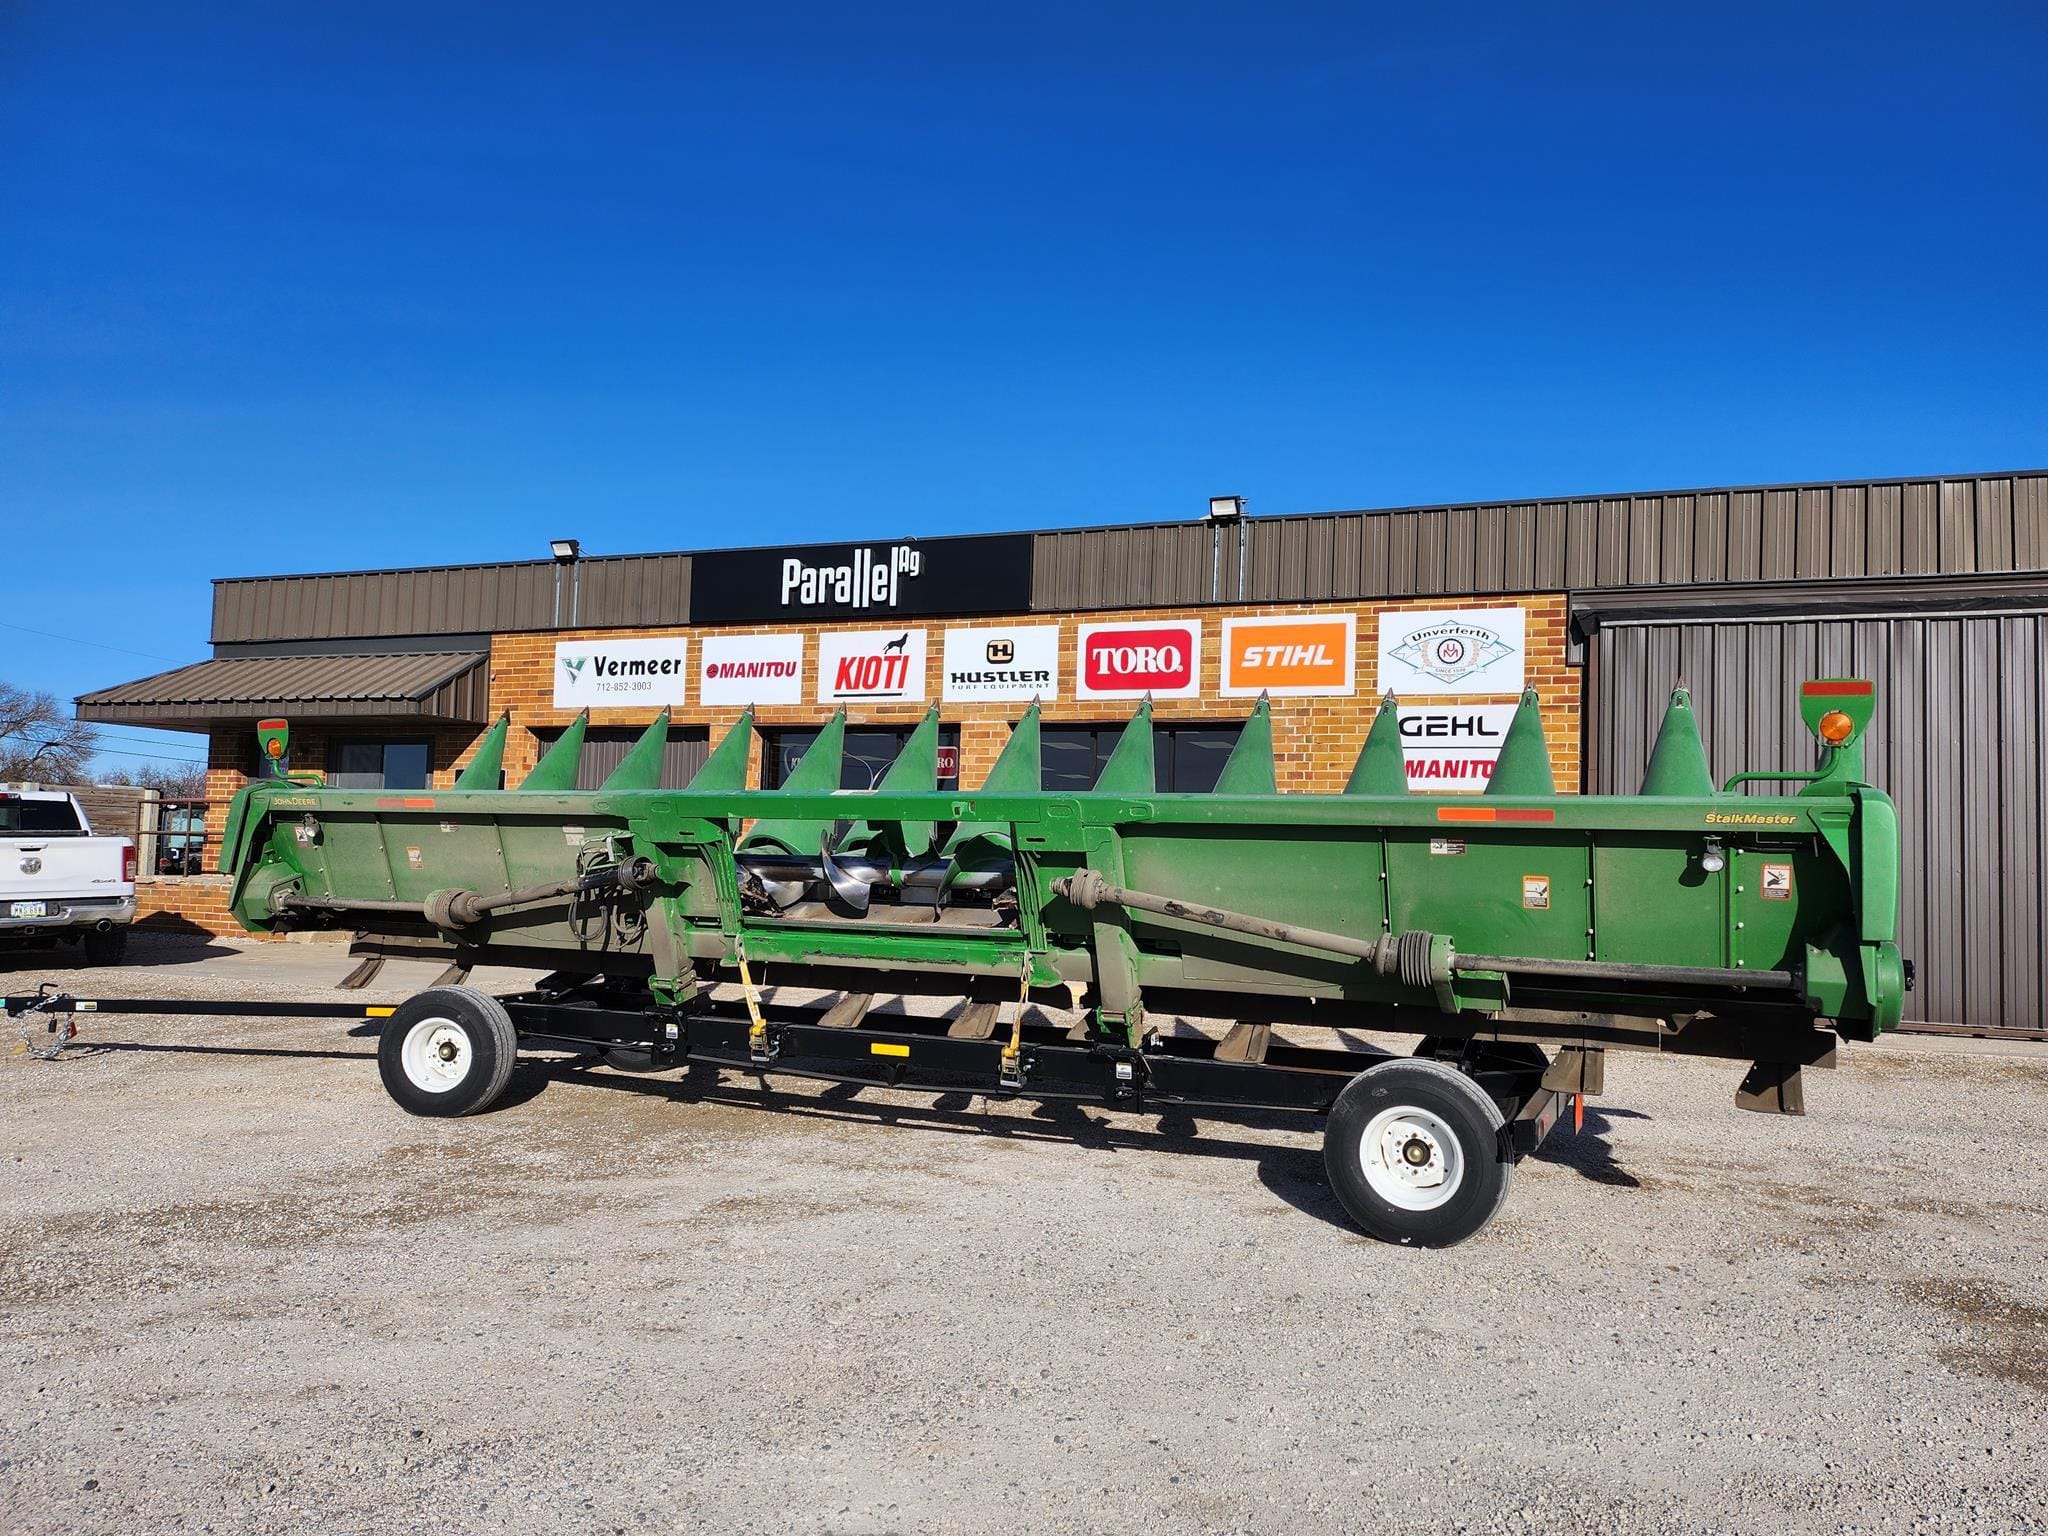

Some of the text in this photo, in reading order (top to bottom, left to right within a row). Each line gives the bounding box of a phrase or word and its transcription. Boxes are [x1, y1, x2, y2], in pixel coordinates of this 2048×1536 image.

[781, 545, 920, 608] Parallel Ag
[1411, 626, 1490, 642] Unverferth
[1240, 644, 1335, 668] STIHL
[593, 656, 682, 677] Vermeer
[719, 661, 797, 679] MANITOU
[834, 655, 911, 690] KIOTI
[950, 670, 1050, 684] HUSTLER
[596, 681, 652, 692] 712-852-3003
[1398, 715, 1500, 736] GEHL
[937, 757, 954, 769] RO
[1405, 759, 1497, 779] MANITO
[273, 797, 316, 806] JOHN DEERE
[1705, 813, 1797, 825] StalkMaster
